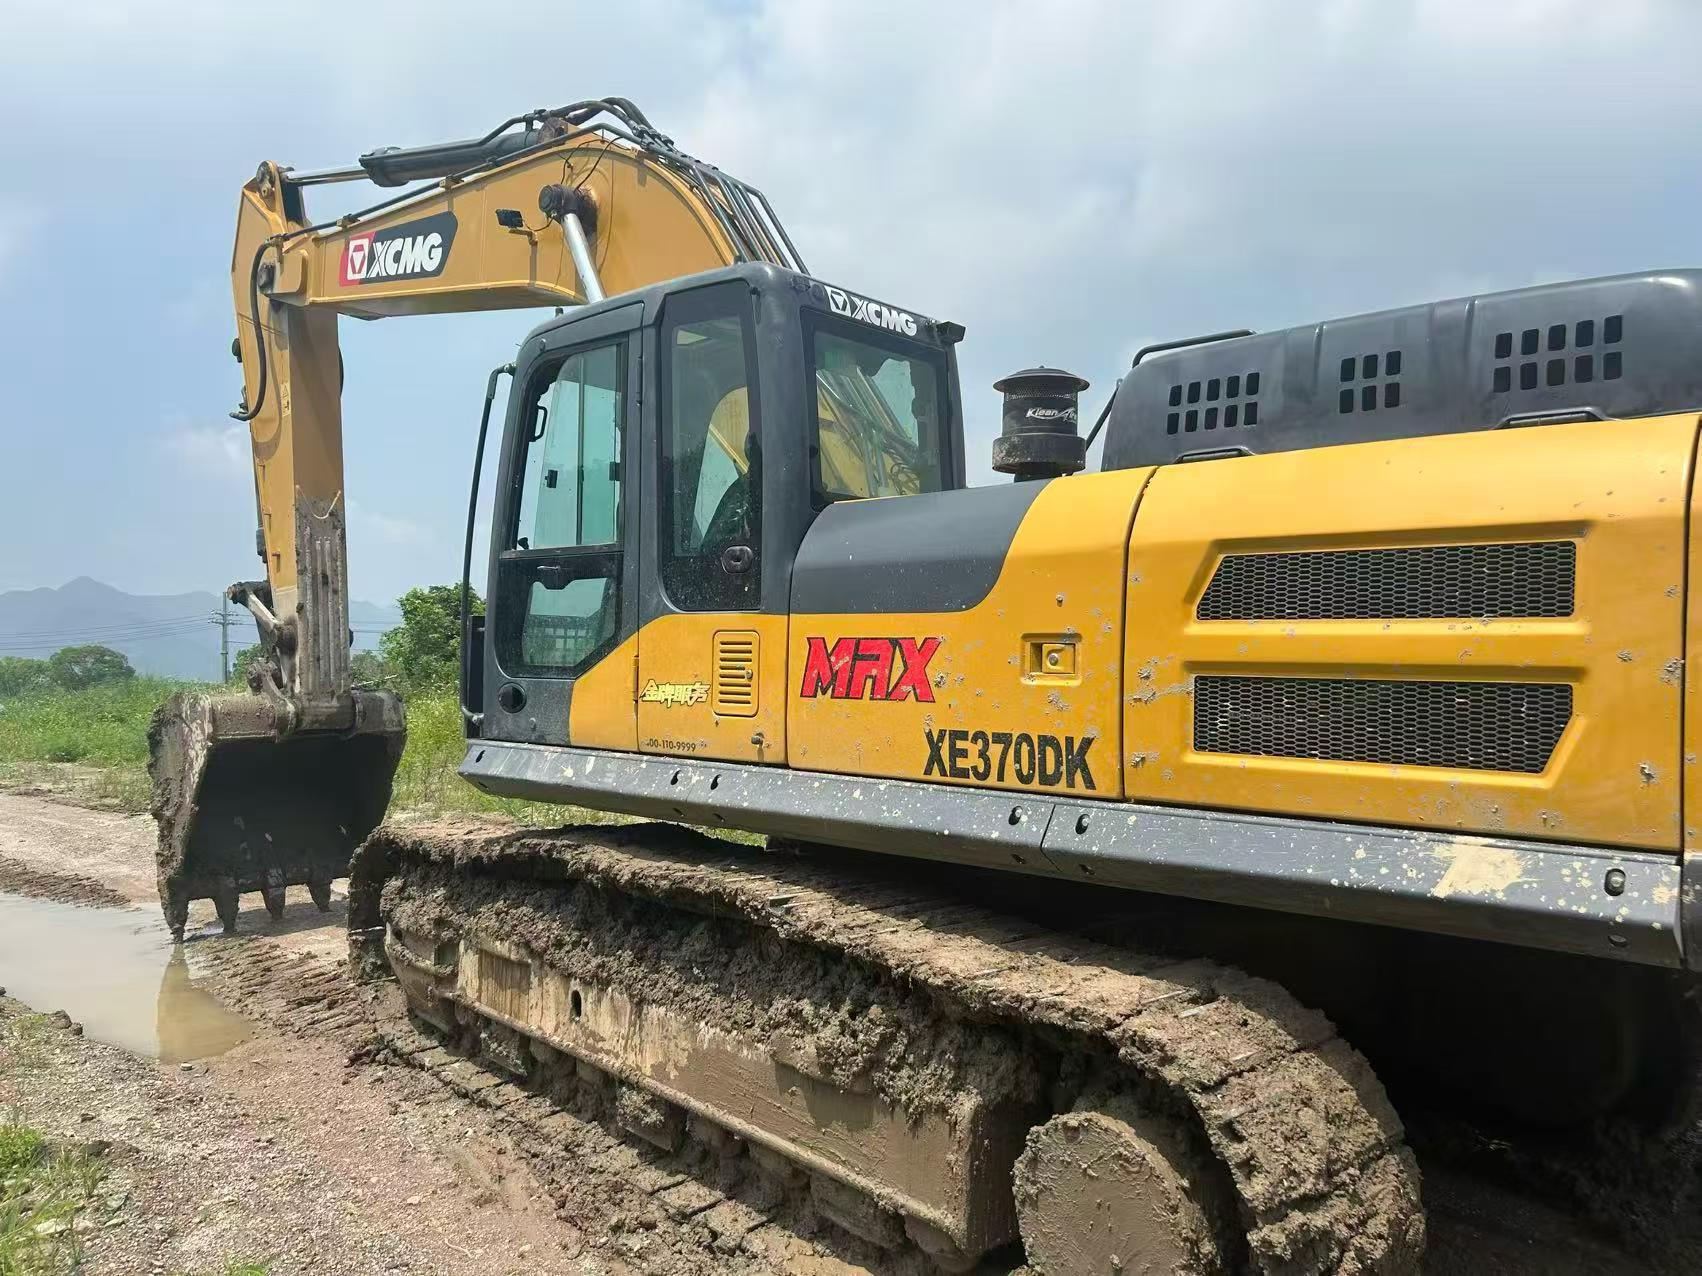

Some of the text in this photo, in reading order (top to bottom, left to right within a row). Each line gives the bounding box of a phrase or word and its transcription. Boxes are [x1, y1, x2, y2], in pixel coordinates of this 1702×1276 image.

[366, 232, 443, 278] XCMG
[850, 295, 917, 336] XCMG
[800, 637, 942, 703] MAX
[645, 738, 696, 752] 00-110-9999
[923, 728, 1096, 790] XE370DK
